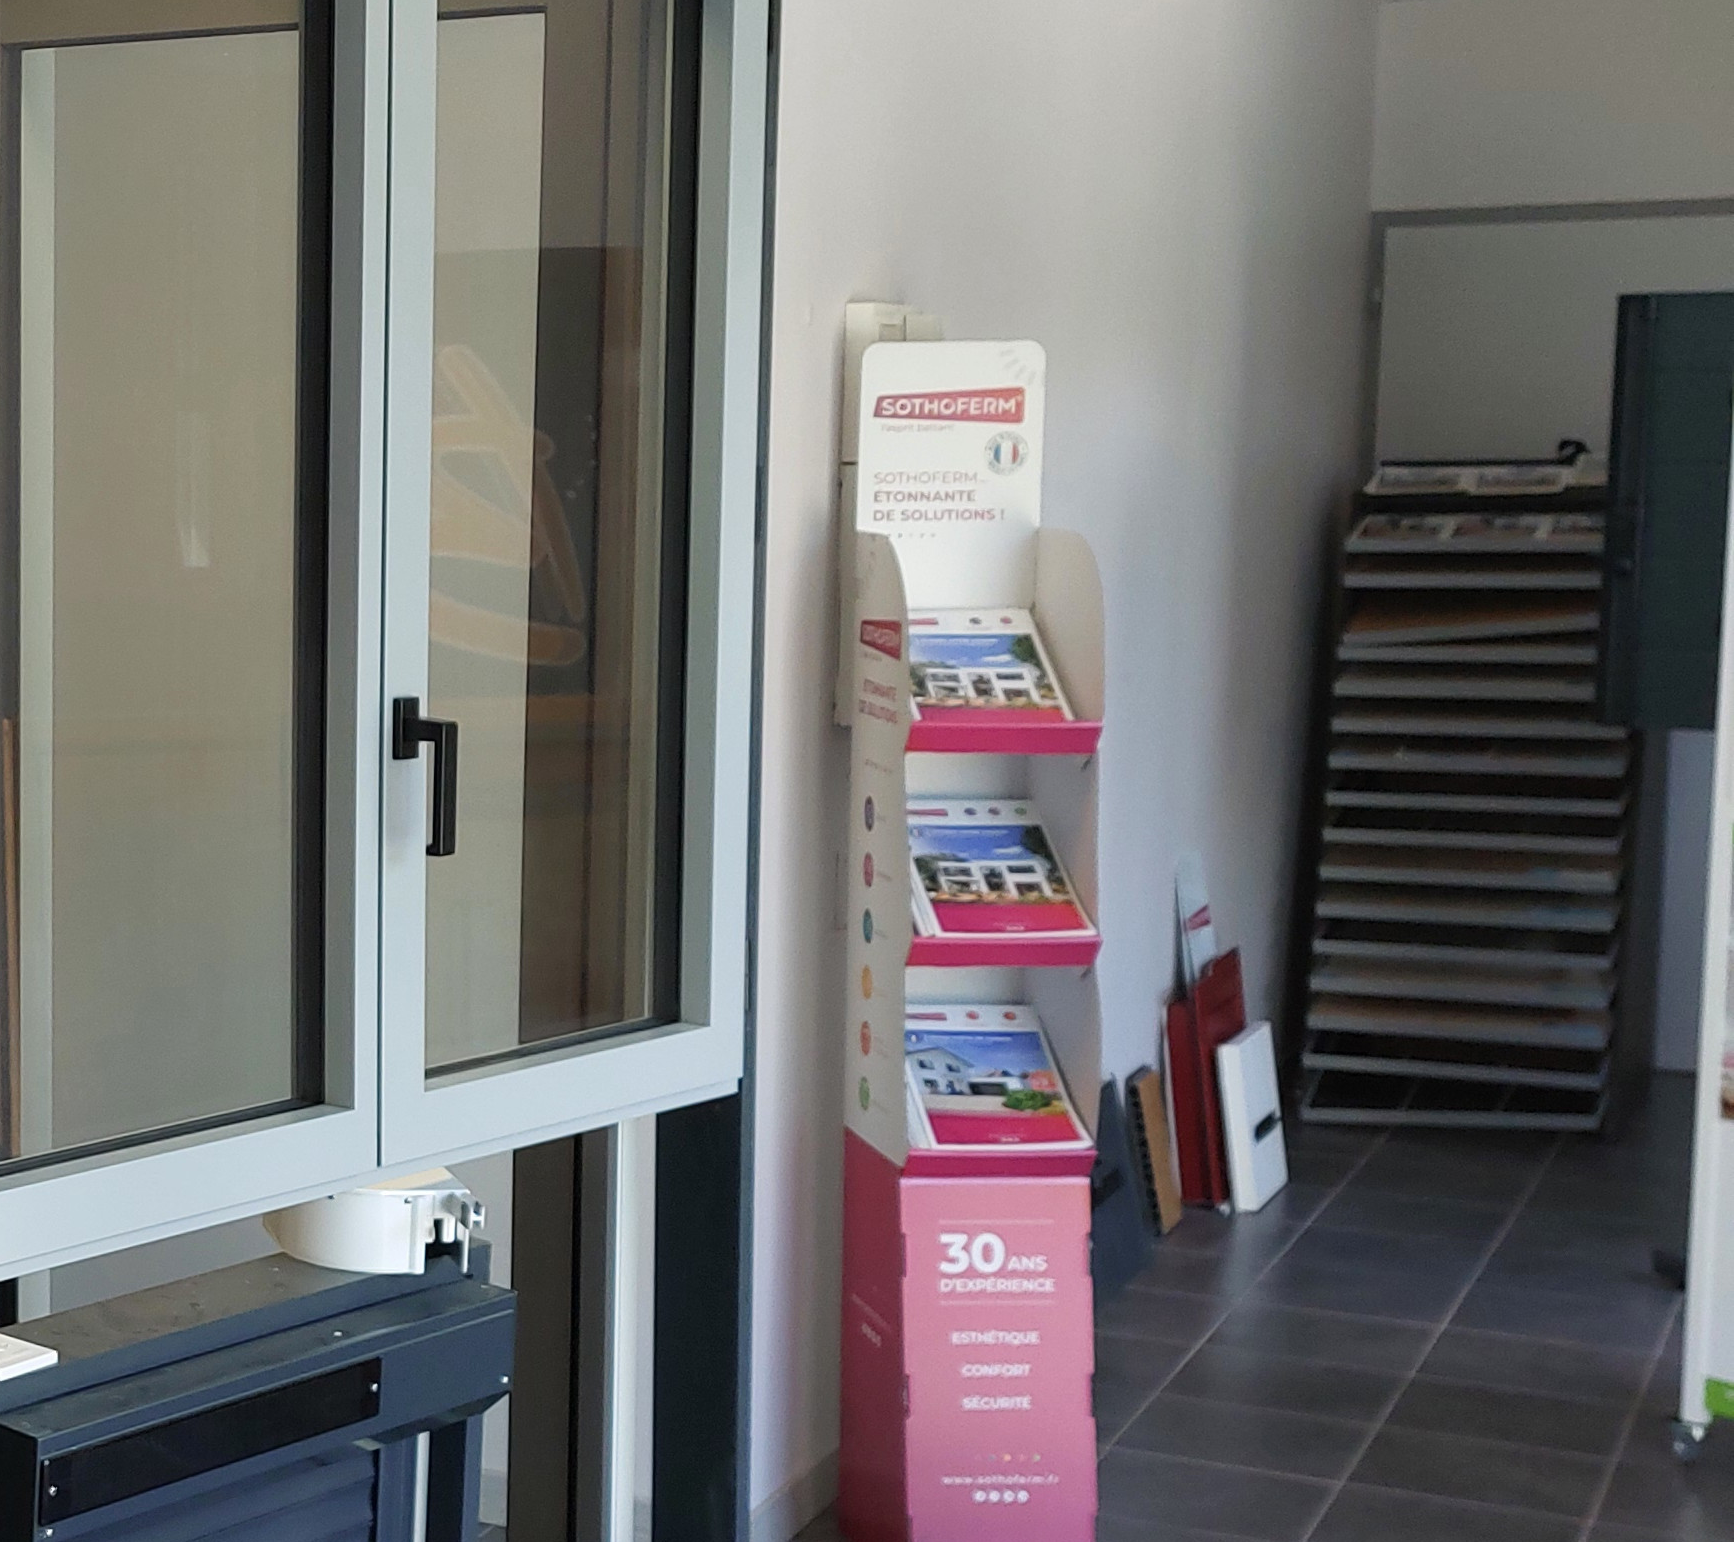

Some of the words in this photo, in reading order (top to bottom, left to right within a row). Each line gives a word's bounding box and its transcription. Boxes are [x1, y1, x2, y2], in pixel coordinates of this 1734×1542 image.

[881, 397, 1016, 415] SOTHOFERM
[873, 509, 896, 522] DE
[900, 507, 996, 521] SOLUTIONS
[939, 1232, 1006, 1274] 30
[1008, 1255, 1049, 1271] ANS
[961, 1363, 1031, 1377] CONFORT
